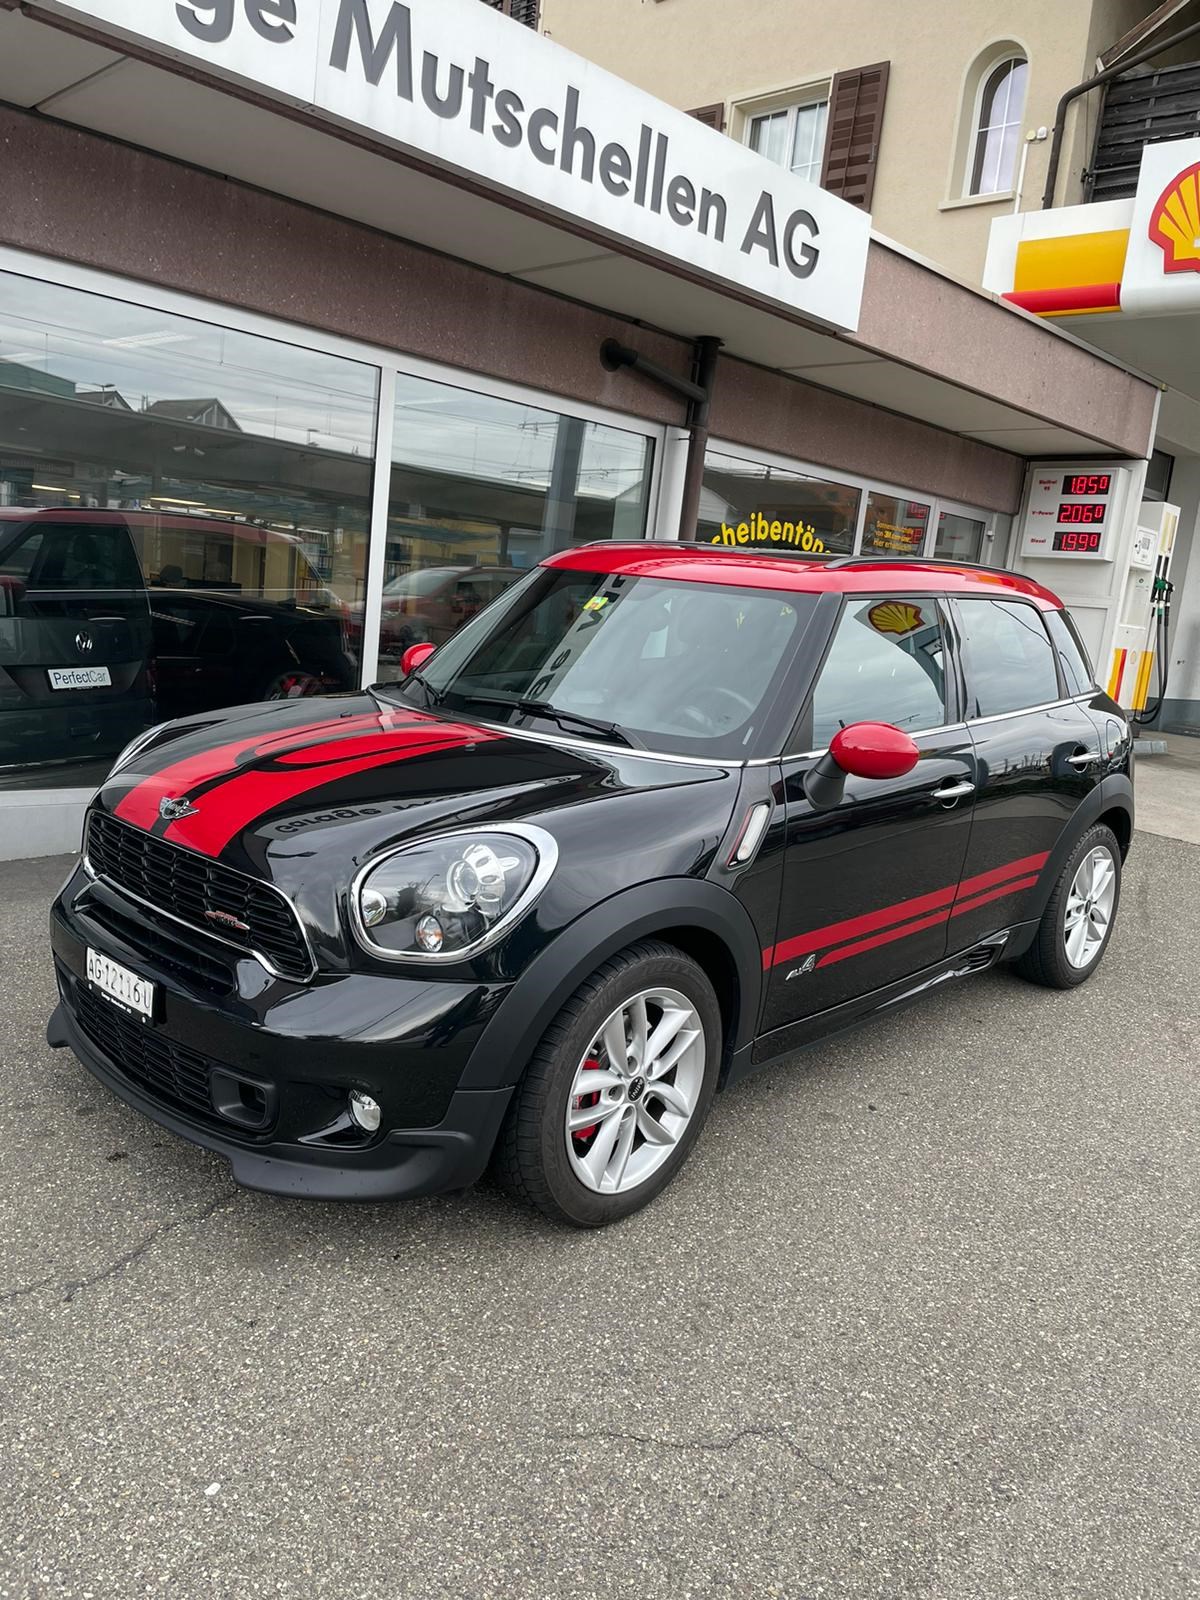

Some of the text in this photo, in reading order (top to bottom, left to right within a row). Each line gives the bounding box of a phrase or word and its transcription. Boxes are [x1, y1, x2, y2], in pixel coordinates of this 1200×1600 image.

[329, 0, 728, 243] Mutschellen
[739, 190, 820, 280] AG
[711, 511, 832, 555] heibentön
[53, 670, 107, 685] PerfectCar
